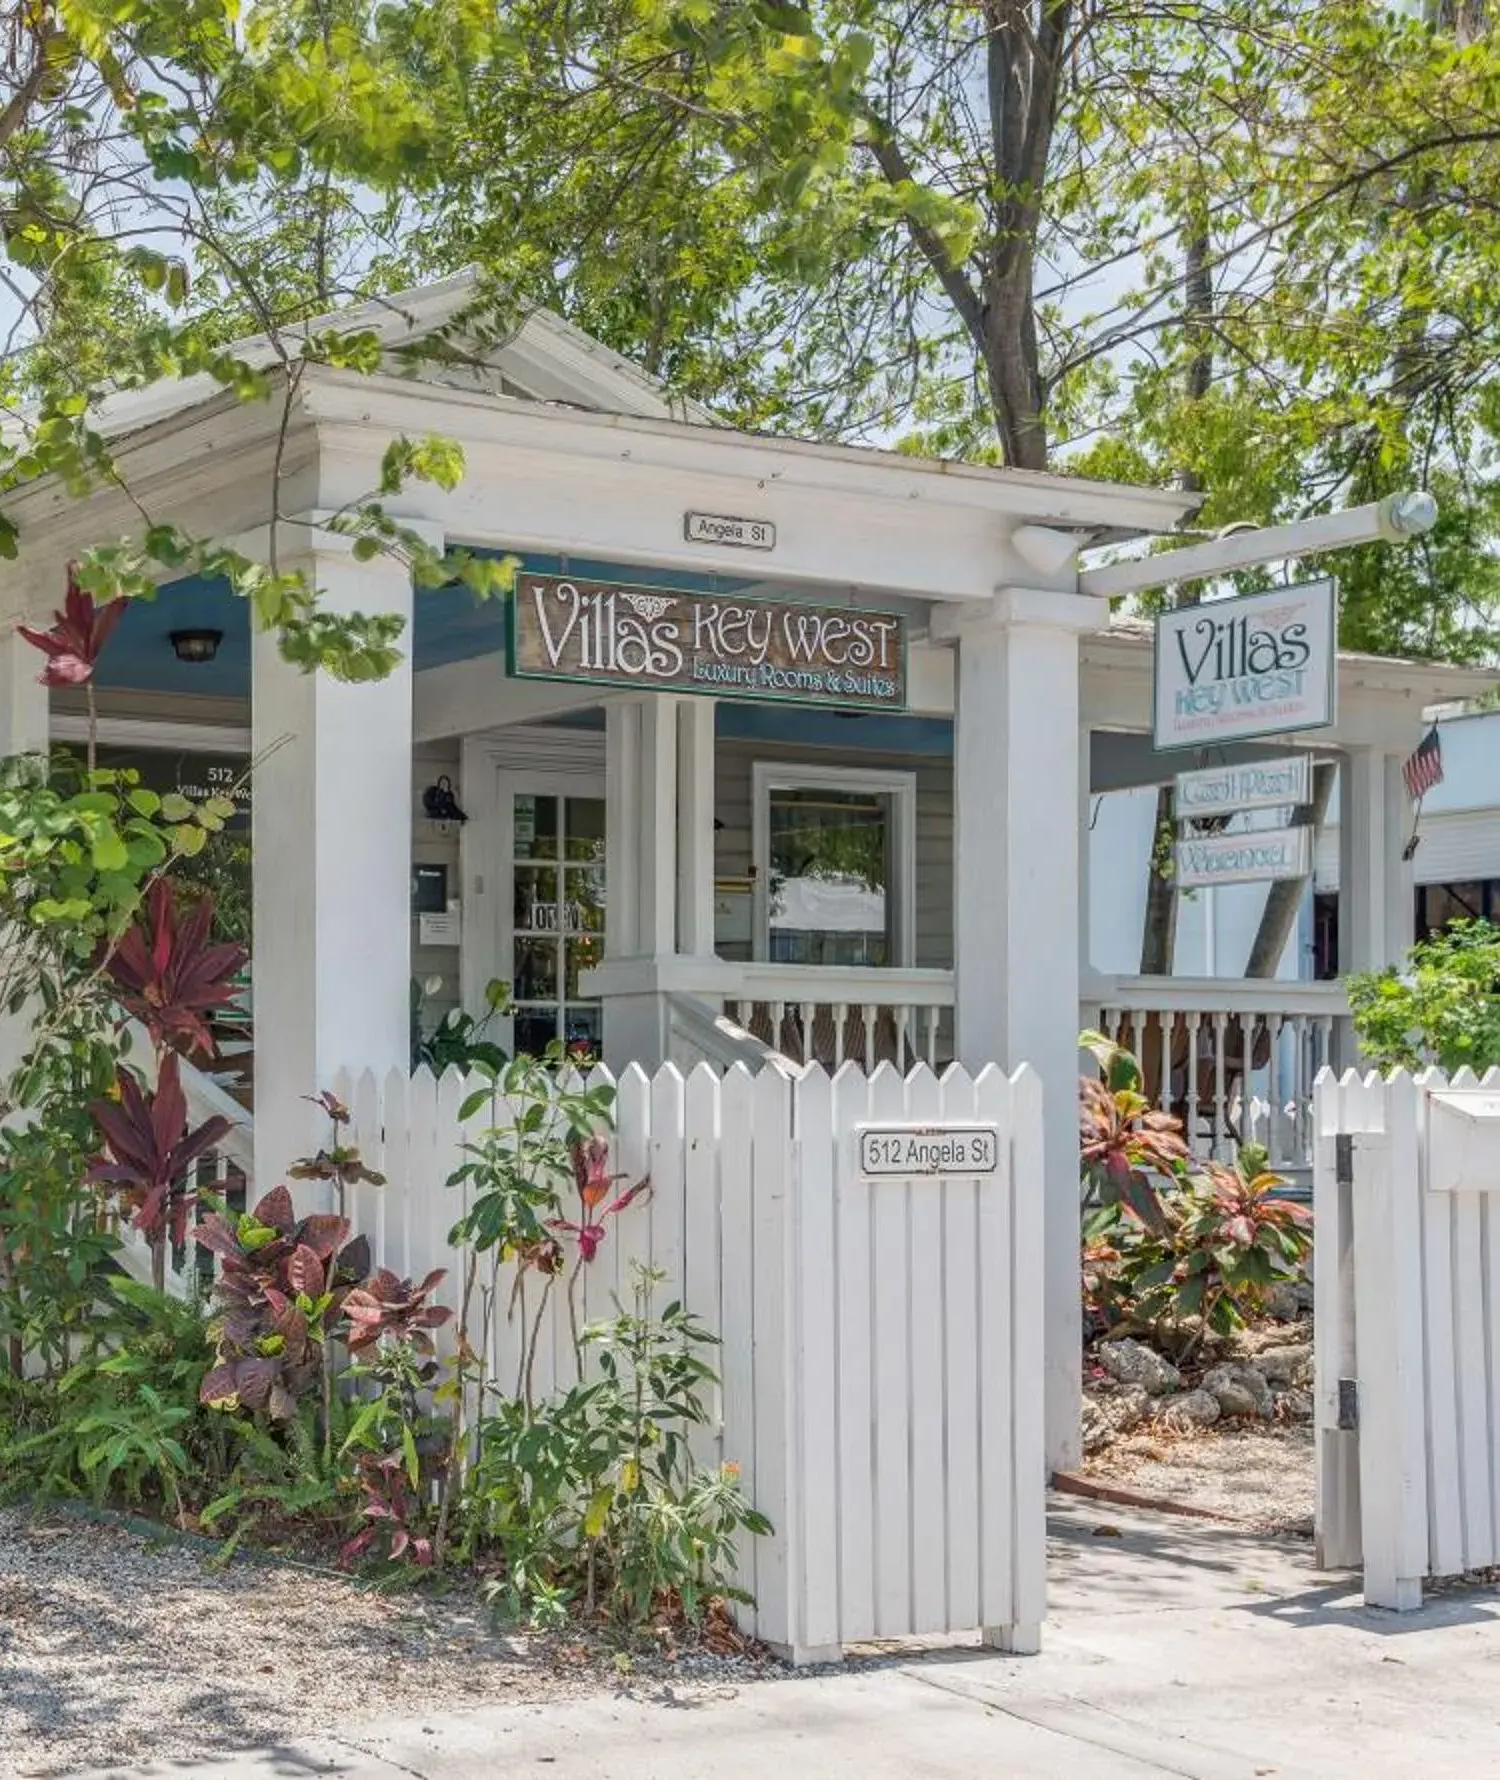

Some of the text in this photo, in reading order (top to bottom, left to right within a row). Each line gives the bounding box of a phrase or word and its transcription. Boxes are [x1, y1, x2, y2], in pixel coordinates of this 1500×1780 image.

[699, 519, 765, 541] Angela St
[532, 583, 683, 677] Villas
[1174, 615, 1311, 685] Villas
[693, 655, 895, 697] Luxury Rooms & Suites
[207, 767, 233, 783] 512
[177, 784, 209, 797] Villas
[869, 1138, 989, 1168] 512 Angela St
